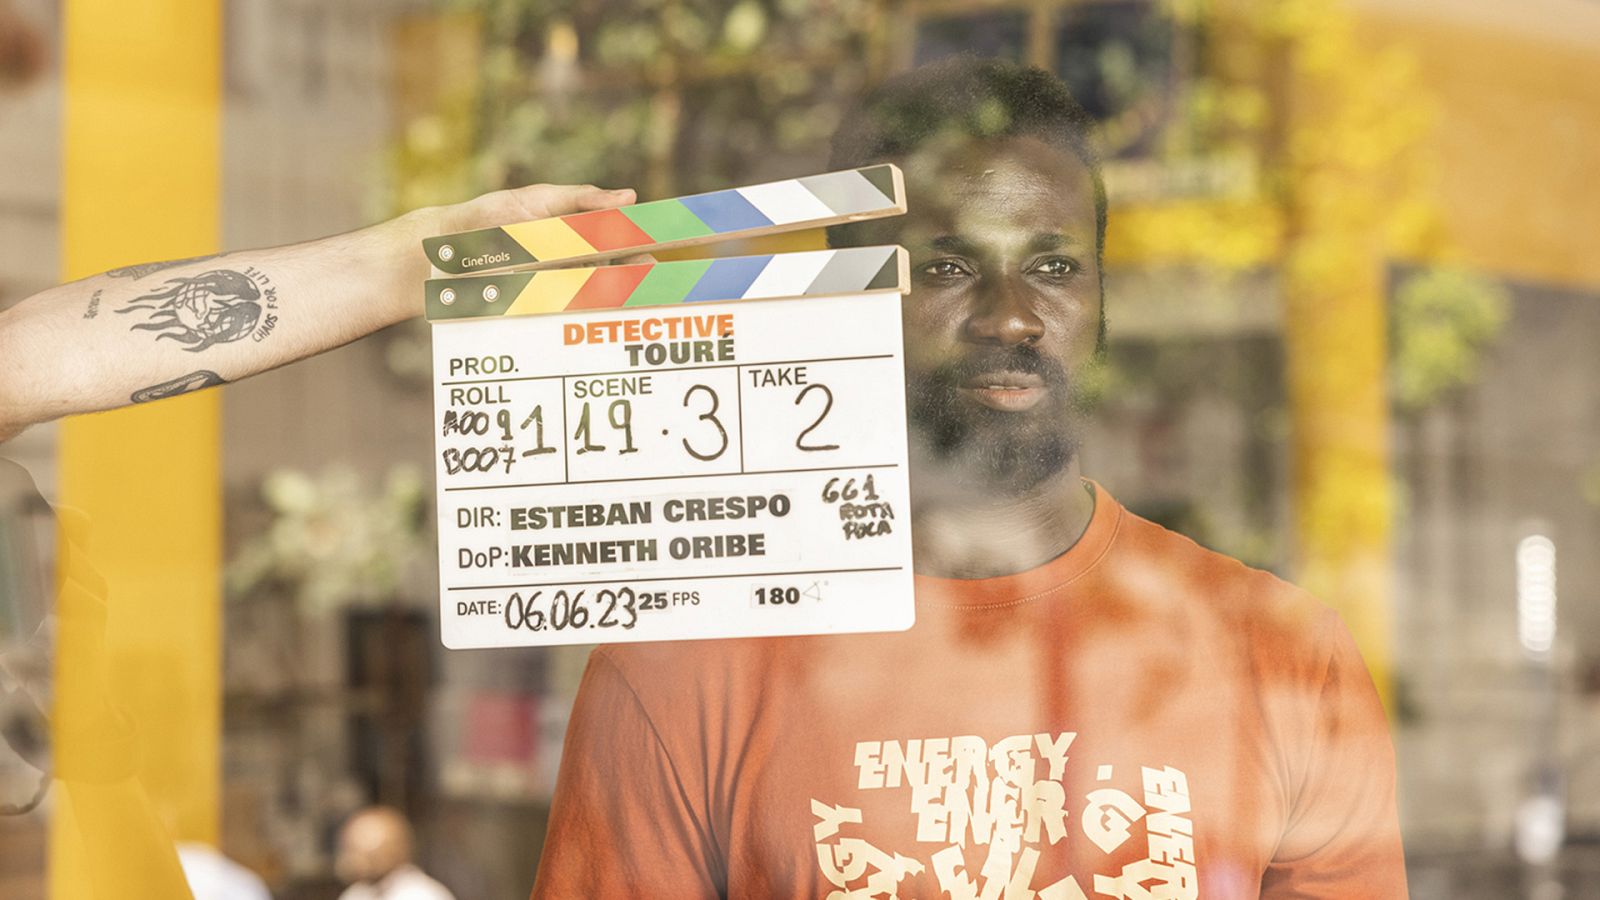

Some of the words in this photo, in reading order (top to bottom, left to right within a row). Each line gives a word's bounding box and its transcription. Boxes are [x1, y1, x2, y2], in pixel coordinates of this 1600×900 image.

[461, 251, 511, 269] CineTools
[244, 266, 270, 285] LIFE
[264, 286, 278, 309] FOR
[252, 314, 278, 342] CHAOS
[563, 313, 735, 346] DETECTIVE
[624, 333, 736, 366] TOURÉ
[449, 354, 520, 376] PROD.
[749, 366, 808, 388] TAKE
[450, 386, 511, 406] ROLL
[573, 376, 653, 399] SCENE
[520, 404, 557, 457] 1
[795, 383, 840, 452] 2
[821, 474, 880, 504] 661
[457, 507, 501, 529] DIR:
[509, 500, 652, 530] ESTEBAN
[663, 493, 791, 522] CRESPO
[457, 546, 509, 569] DoP:
[511, 538, 658, 567] KENNETH
[668, 533, 766, 560] ORIBE
[456, 599, 502, 616] DATE:
[504, 587, 638, 632] 06.06.23
[638, 592, 669, 611] 25
[672, 590, 701, 607] FPS
[854, 732, 1077, 789] ENERGY
